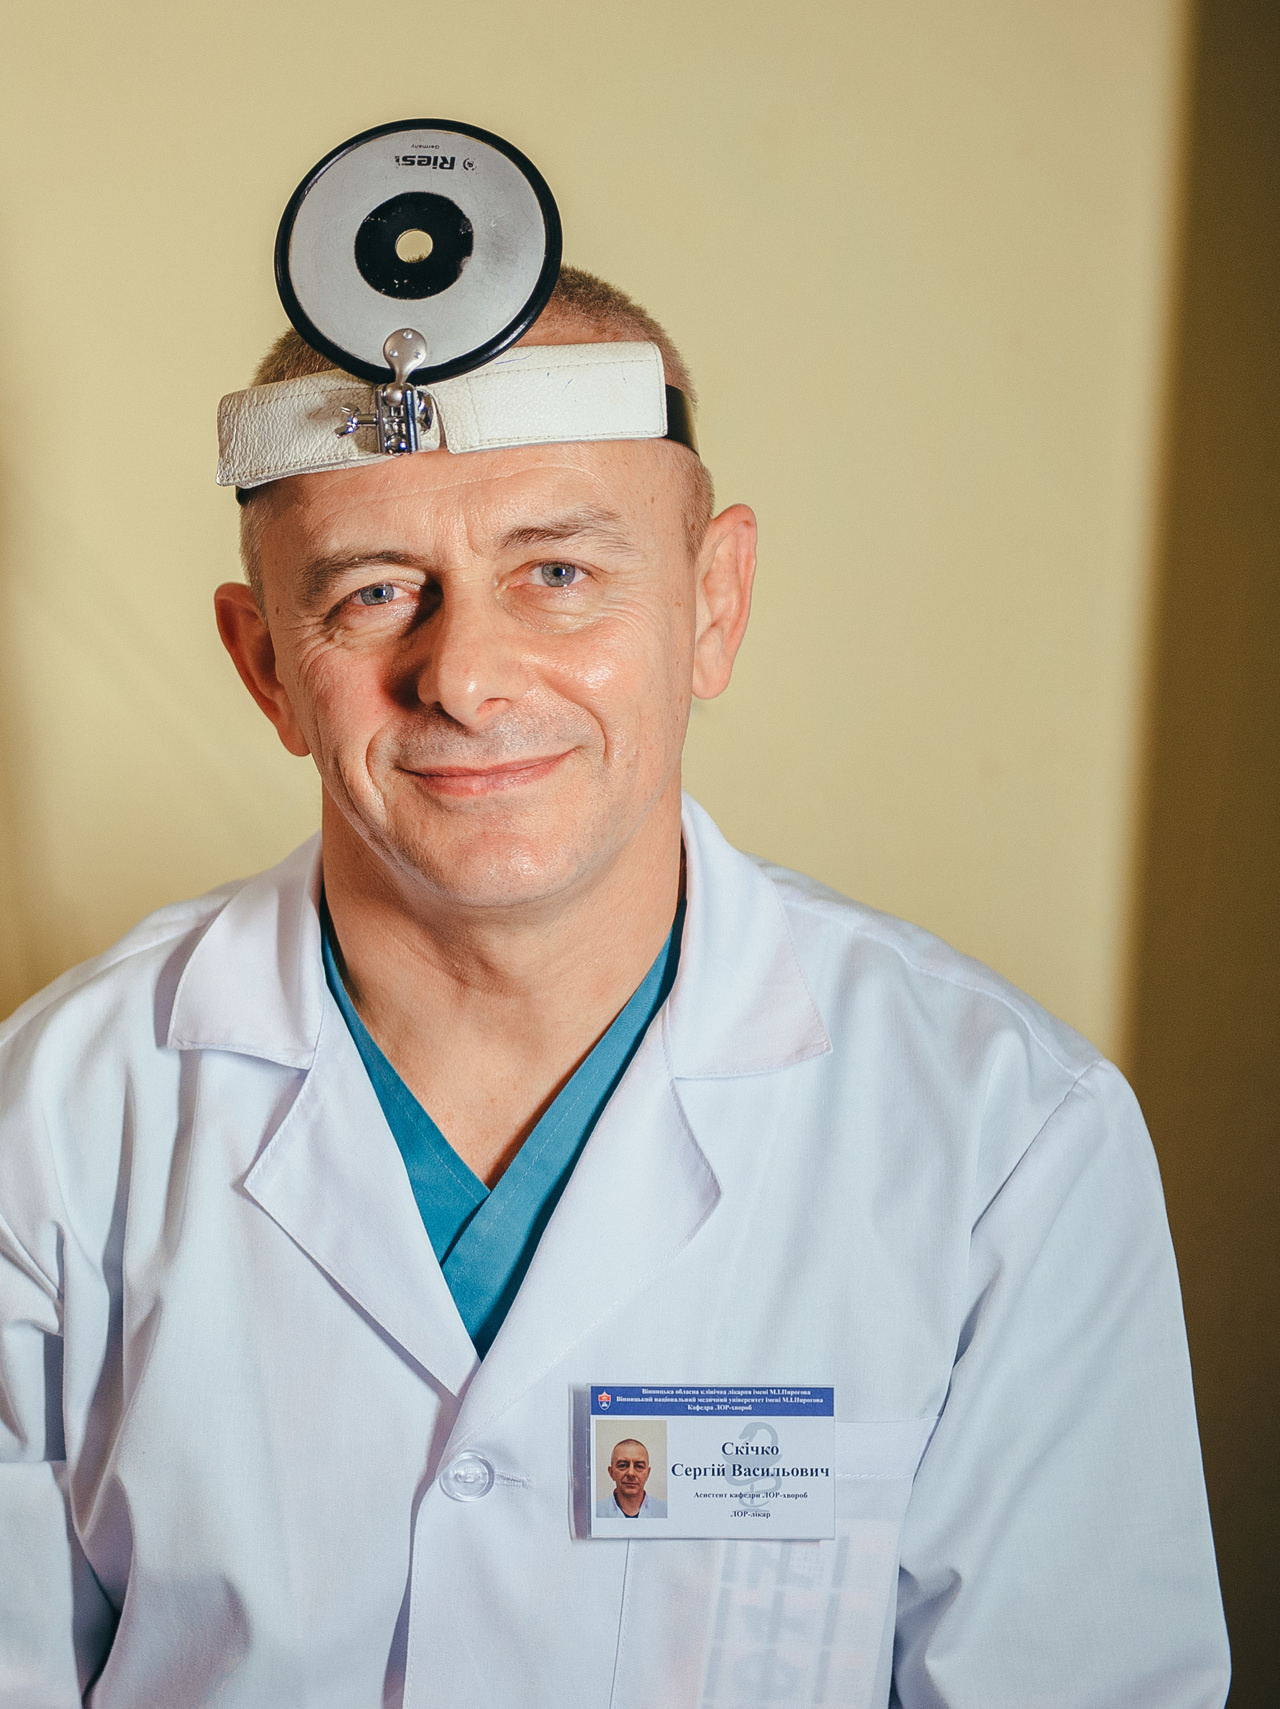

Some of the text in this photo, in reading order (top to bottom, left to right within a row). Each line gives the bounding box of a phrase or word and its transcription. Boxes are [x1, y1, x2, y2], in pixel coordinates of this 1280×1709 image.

[687, 1404, 714, 1412] Кафедра
[721, 1441, 780, 1456] Скічко
[671, 1463, 830, 1480] Сергій Васильович
[693, 1491, 808, 1500] Асистент кафедри ЛОР-хвороб
[730, 1511, 771, 1519] ЛОР-лікар
